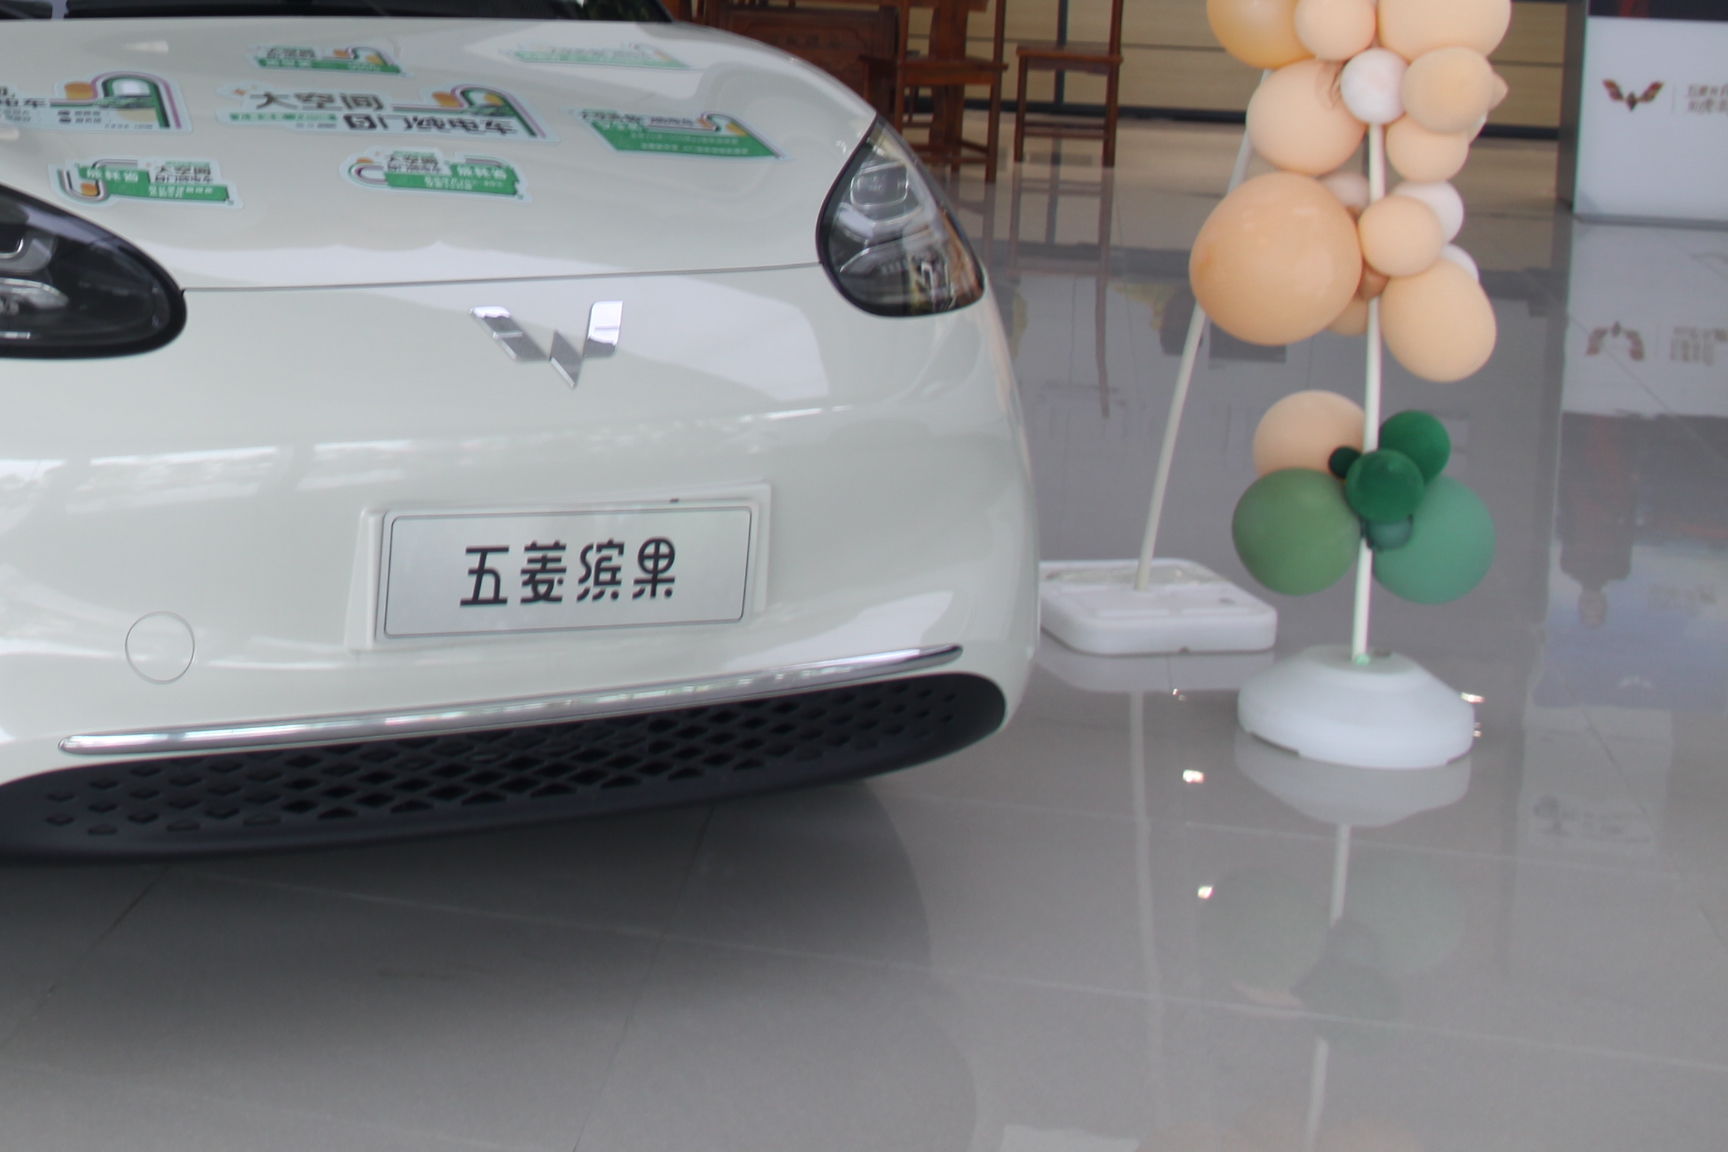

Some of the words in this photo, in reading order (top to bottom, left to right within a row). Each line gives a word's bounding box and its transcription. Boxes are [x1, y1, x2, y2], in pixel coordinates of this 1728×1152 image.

[249, 90, 385, 111] 大空间
[459, 536, 676, 608] 五菱缤果
